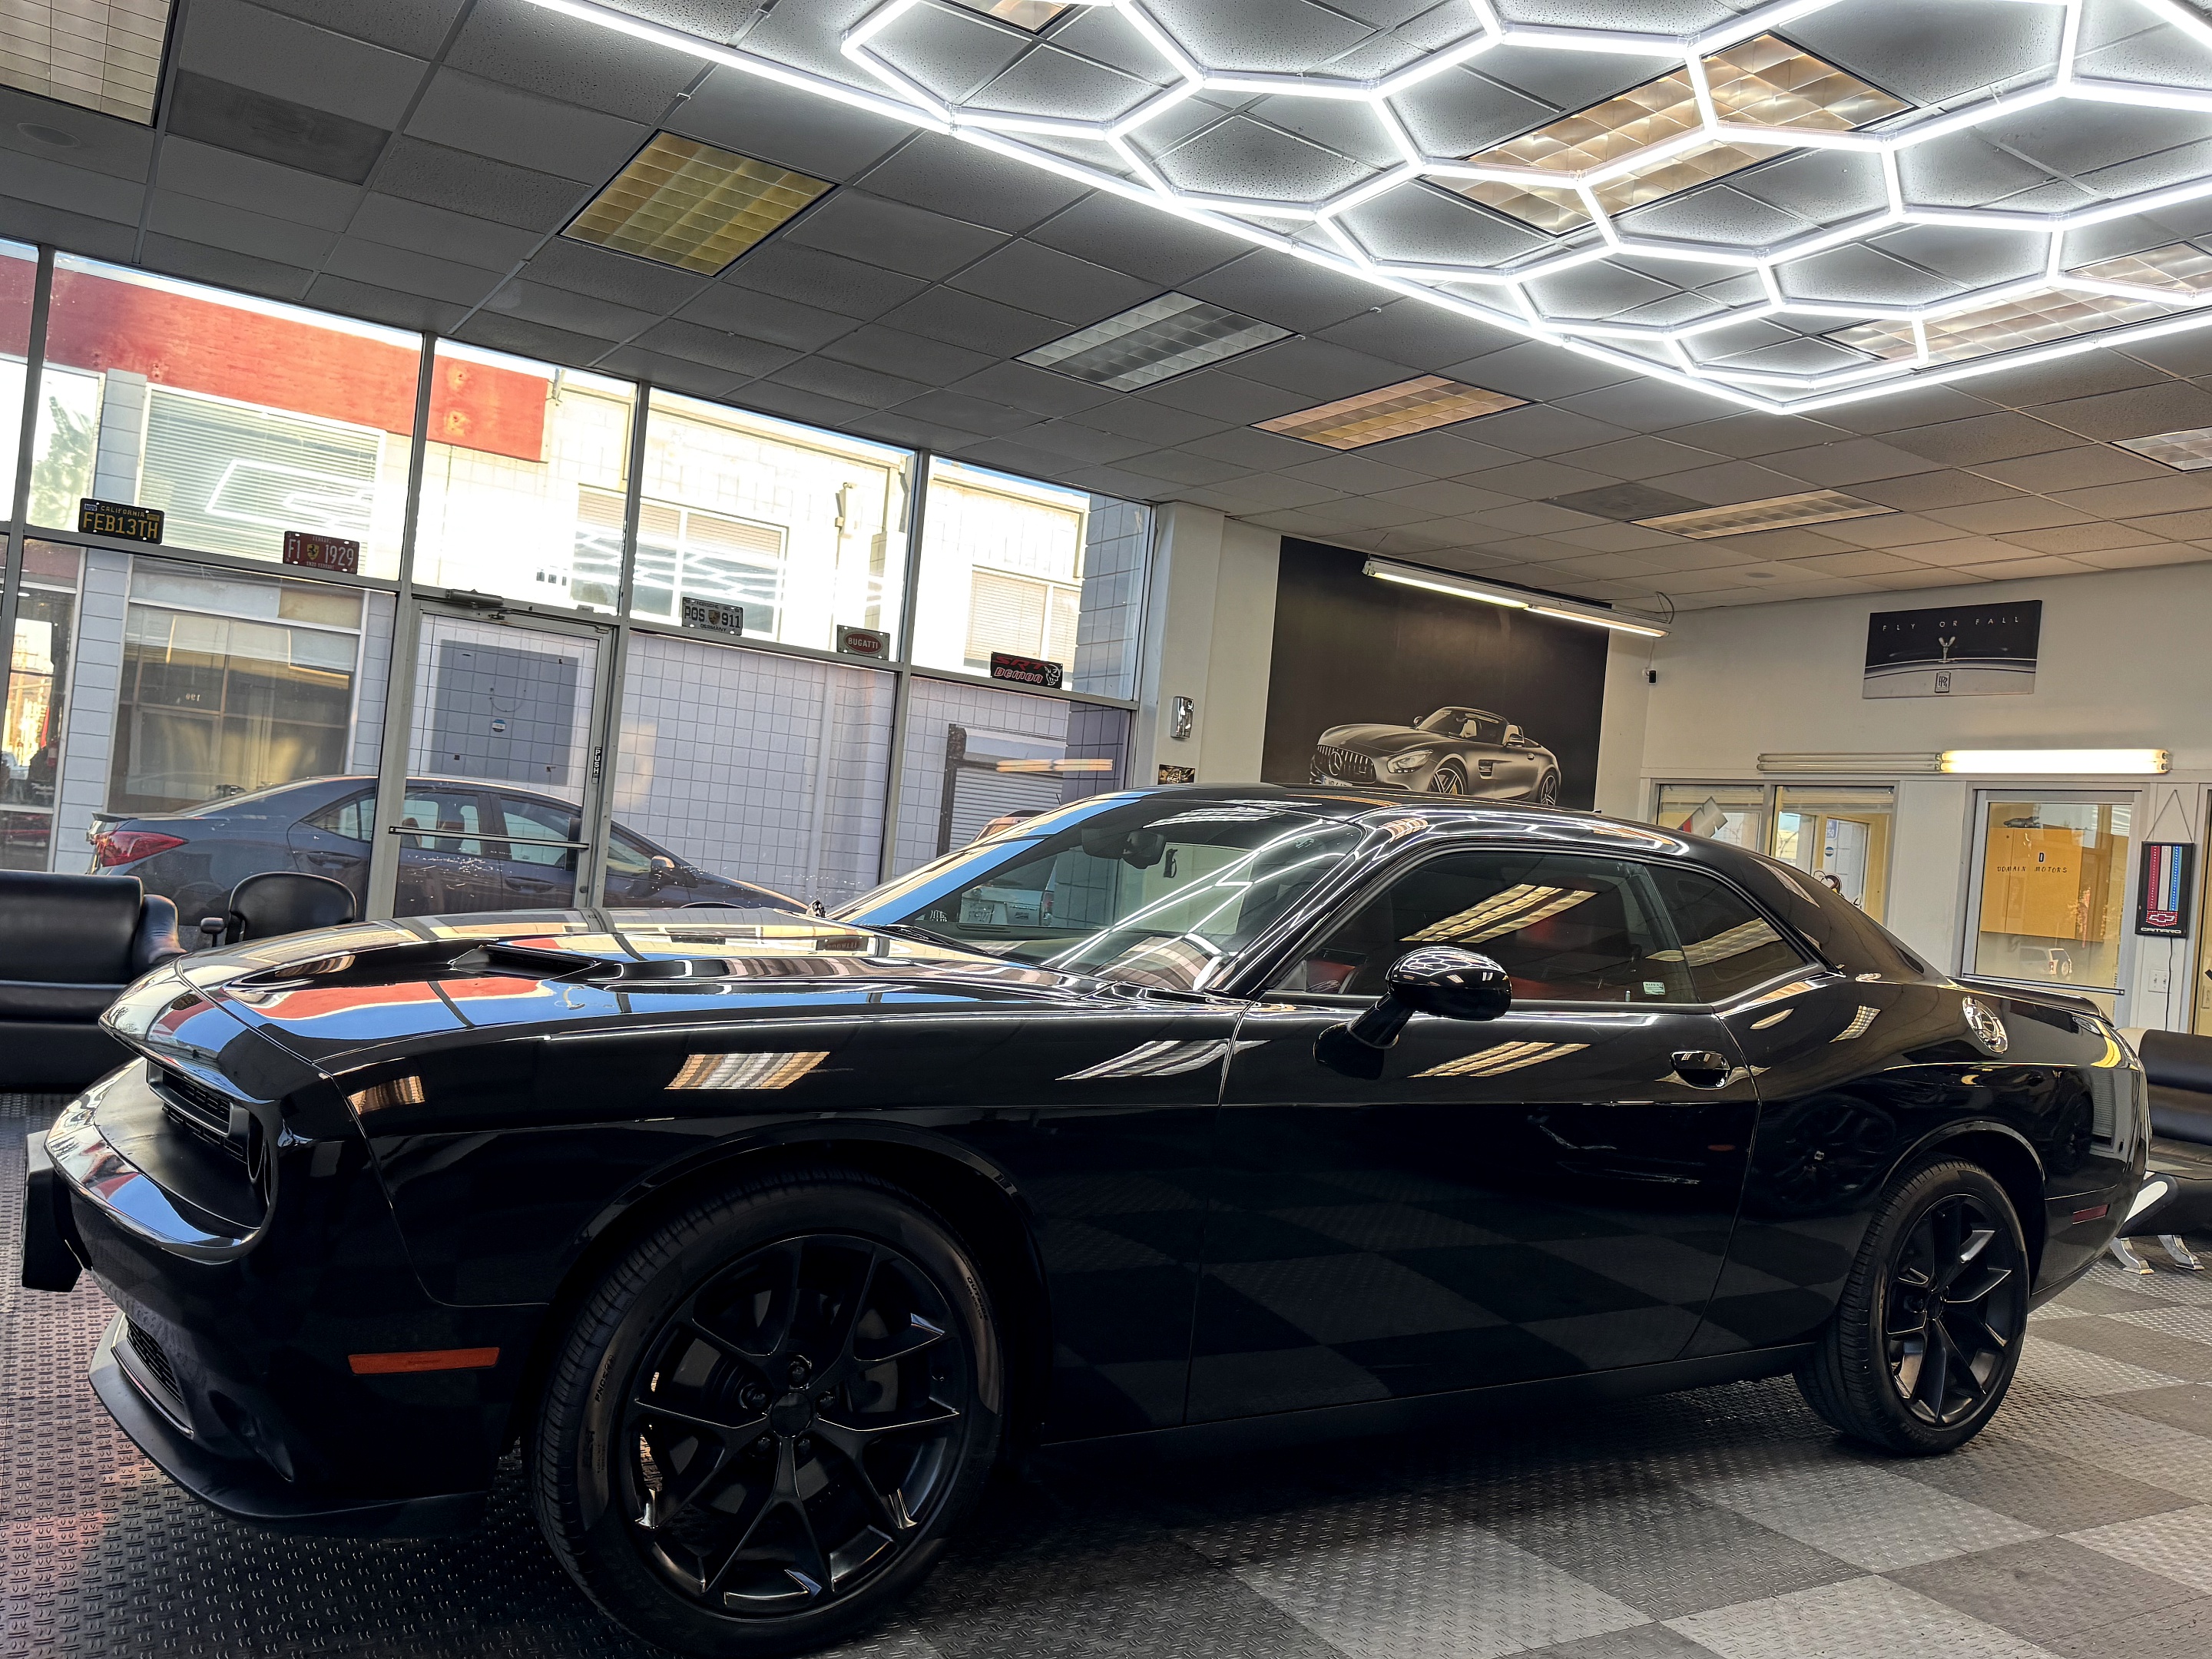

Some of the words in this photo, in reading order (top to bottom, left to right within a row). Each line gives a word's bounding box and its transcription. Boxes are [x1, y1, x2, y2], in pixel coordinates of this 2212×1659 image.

[101, 505, 145, 518] CALIFORNIA
[83, 511, 158, 538] FEB13TH
[288, 538, 301, 559] F1
[325, 544, 354, 566] 1929
[722, 612, 740, 628] 911
[1883, 623, 1916, 631] FLY
[1939, 620, 1958, 628] OR
[1975, 616, 2018, 625] FALL
[848, 637, 879, 649] BUGATTI
[993, 656, 1048, 671] SRT
[593, 749, 601, 774] PUSH
